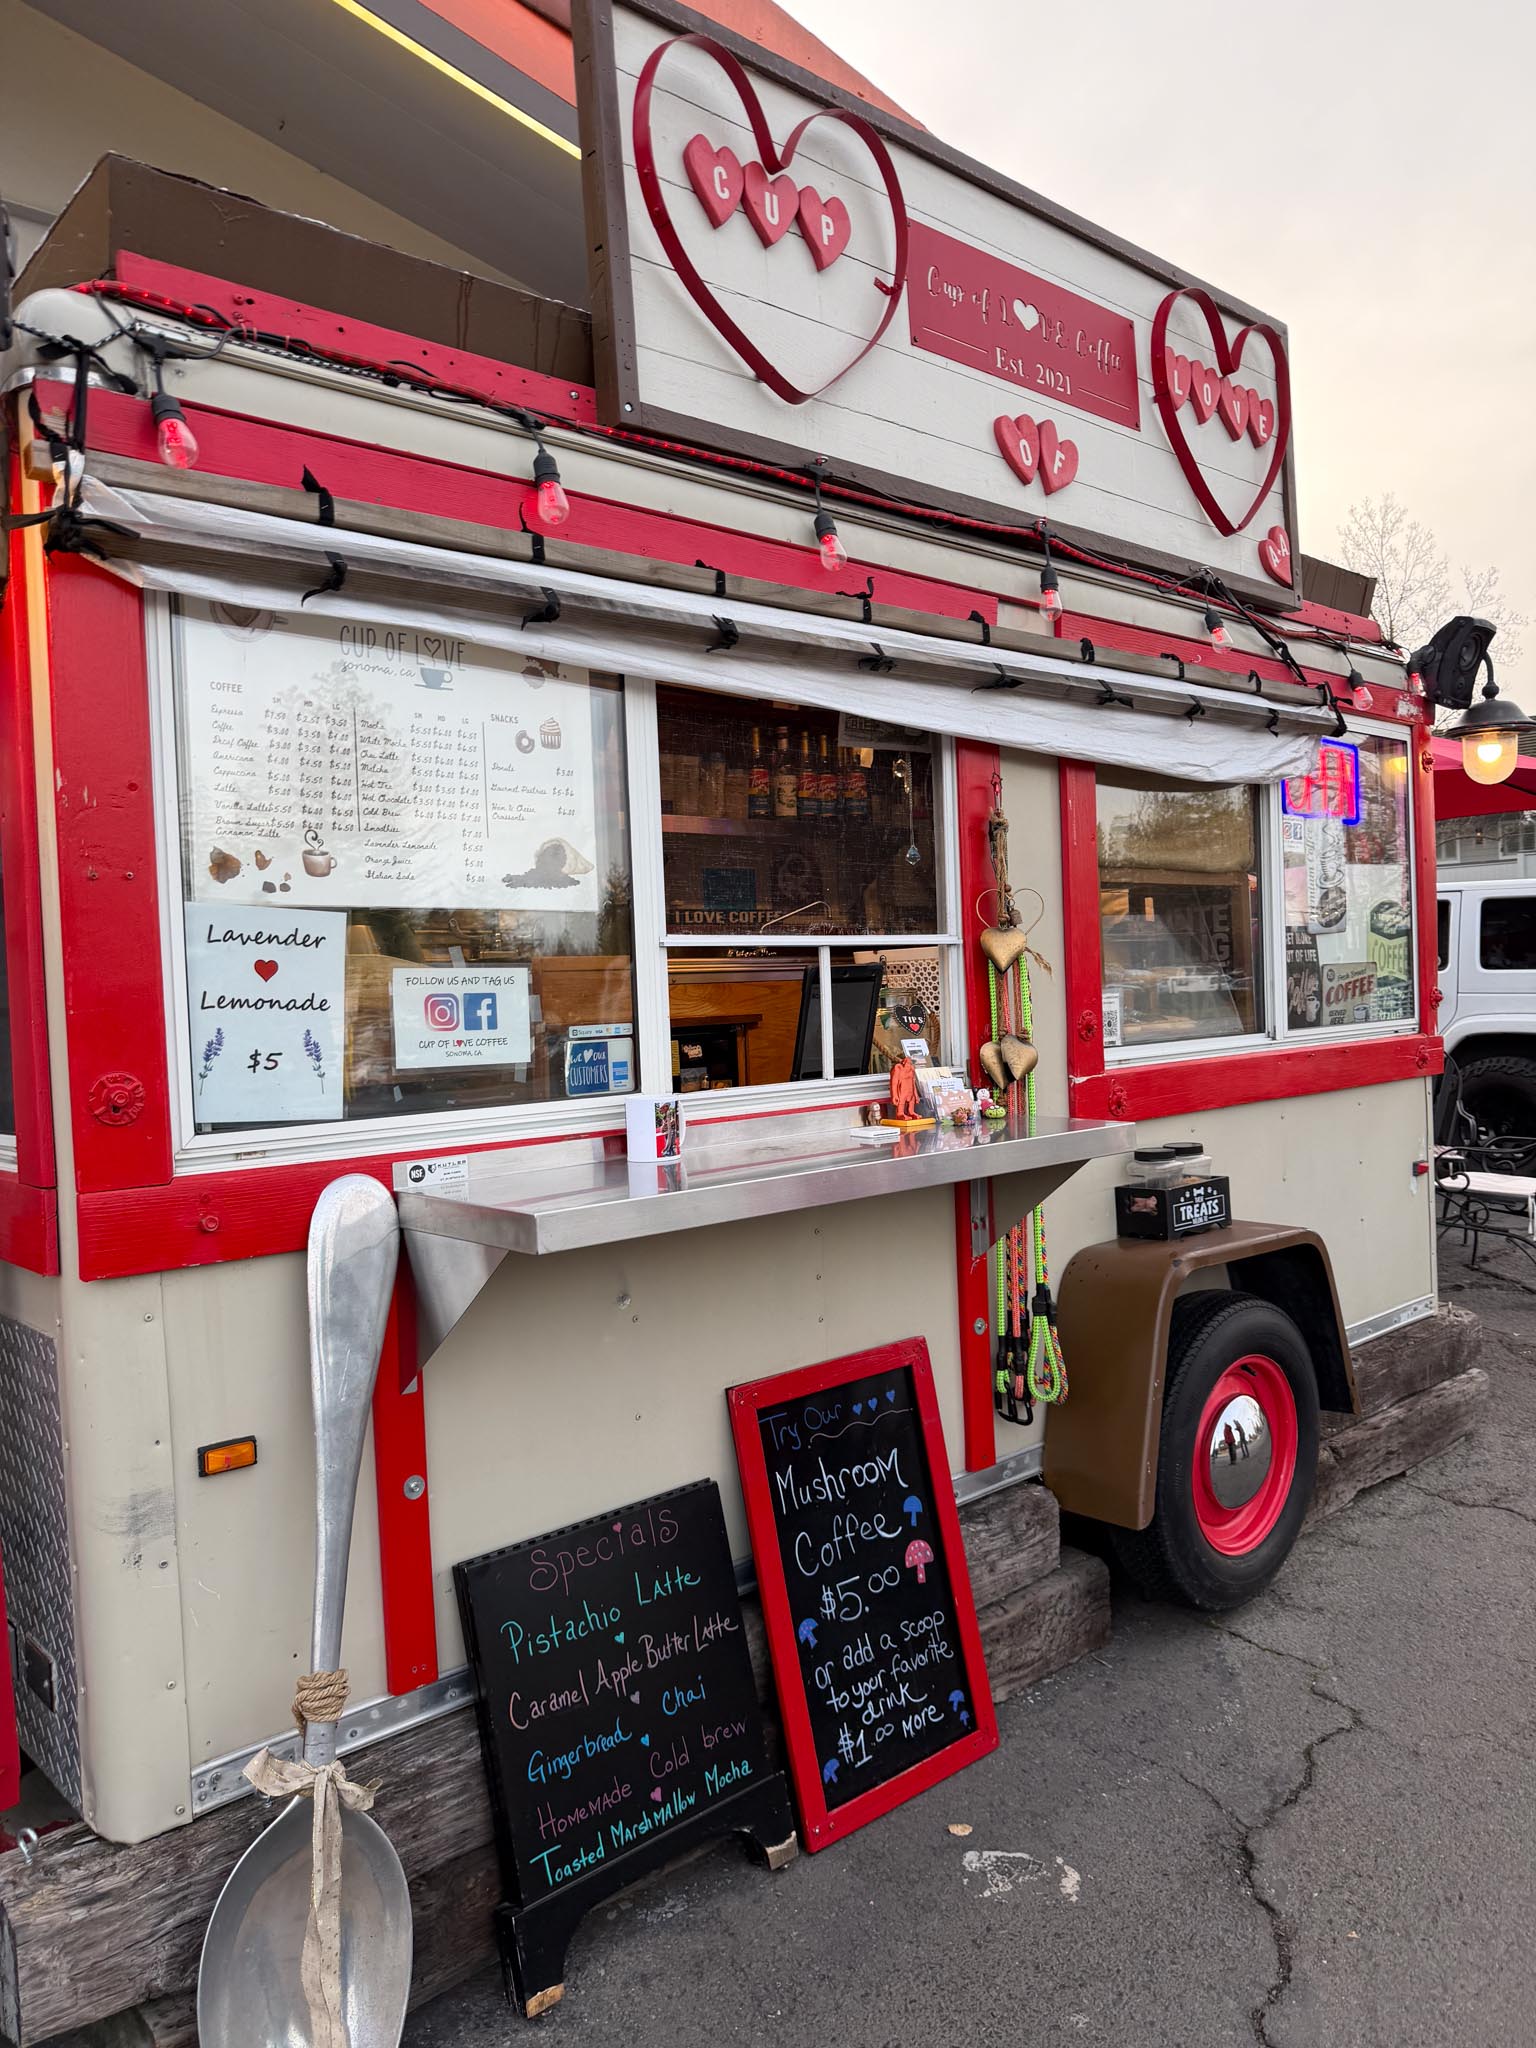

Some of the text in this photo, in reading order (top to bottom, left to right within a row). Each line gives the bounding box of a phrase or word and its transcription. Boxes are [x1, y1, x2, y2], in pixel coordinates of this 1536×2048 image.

[713, 165, 836, 246] CUP
[927, 265, 965, 307] Cup
[971, 288, 992, 325] of
[994, 346, 1073, 396] Est. 2021
[1019, 438, 1066, 473] OF
[340, 625, 376, 658] CUP
[385, 631, 407, 663] OF
[209, 681, 243, 693] COFFEE
[211, 720, 234, 733] Coffee
[490, 713, 519, 724] SNACKS
[212, 735, 235, 748] Decaf
[237, 738, 260, 750] Coffee
[361, 779, 375, 789] Hot
[361, 793, 375, 802] Hot
[362, 807, 401, 817] Cold Brew
[363, 823, 401, 833] Smoothies
[364, 838, 438, 850] Lavender Lemonade
[364, 855, 413, 866] Orange Juice
[365, 869, 416, 881] Italian Soda
[675, 911, 680, 923] I
[685, 911, 724, 924] LOVE
[206, 923, 327, 949] Lavender
[1304, 949, 1318, 962] LIFE
[404, 975, 515, 987] FOLLOW US AND TAG US
[1324, 974, 1375, 1007] COFFEE
[200, 990, 331, 1012] Lemonade
[902, 1015, 923, 1023] TIPS
[418, 1040, 436, 1049] CUP
[437, 1039, 450, 1048] OF
[475, 1037, 508, 1047] COFFEE
[474, 1049, 483, 1057] CA
[246, 1049, 283, 1073] $5
[570, 1064, 608, 1087] CUSTOMERS
[410, 1168, 424, 1180] NSF
[1179, 1198, 1219, 1221] TREATS
[757, 1403, 842, 1450] Try Our
[529, 1508, 680, 1596] Specials
[795, 1512, 903, 1577] Coffee
[500, 1565, 701, 1665] Pistachio Latte
[814, 1610, 945, 1690] or add a scoop
[508, 1611, 739, 1730] Caramel Apple Butter Latte
[826, 1632, 955, 1713] to your favorite
[861, 1682, 928, 1726] drink
[528, 1675, 706, 1784] Gingerbread Chai
[650, 1735, 691, 1778] Cold
[700, 1716, 749, 1750] brew
[529, 1831, 605, 1887] Toasted
[704, 1759, 753, 1797] Mocha
